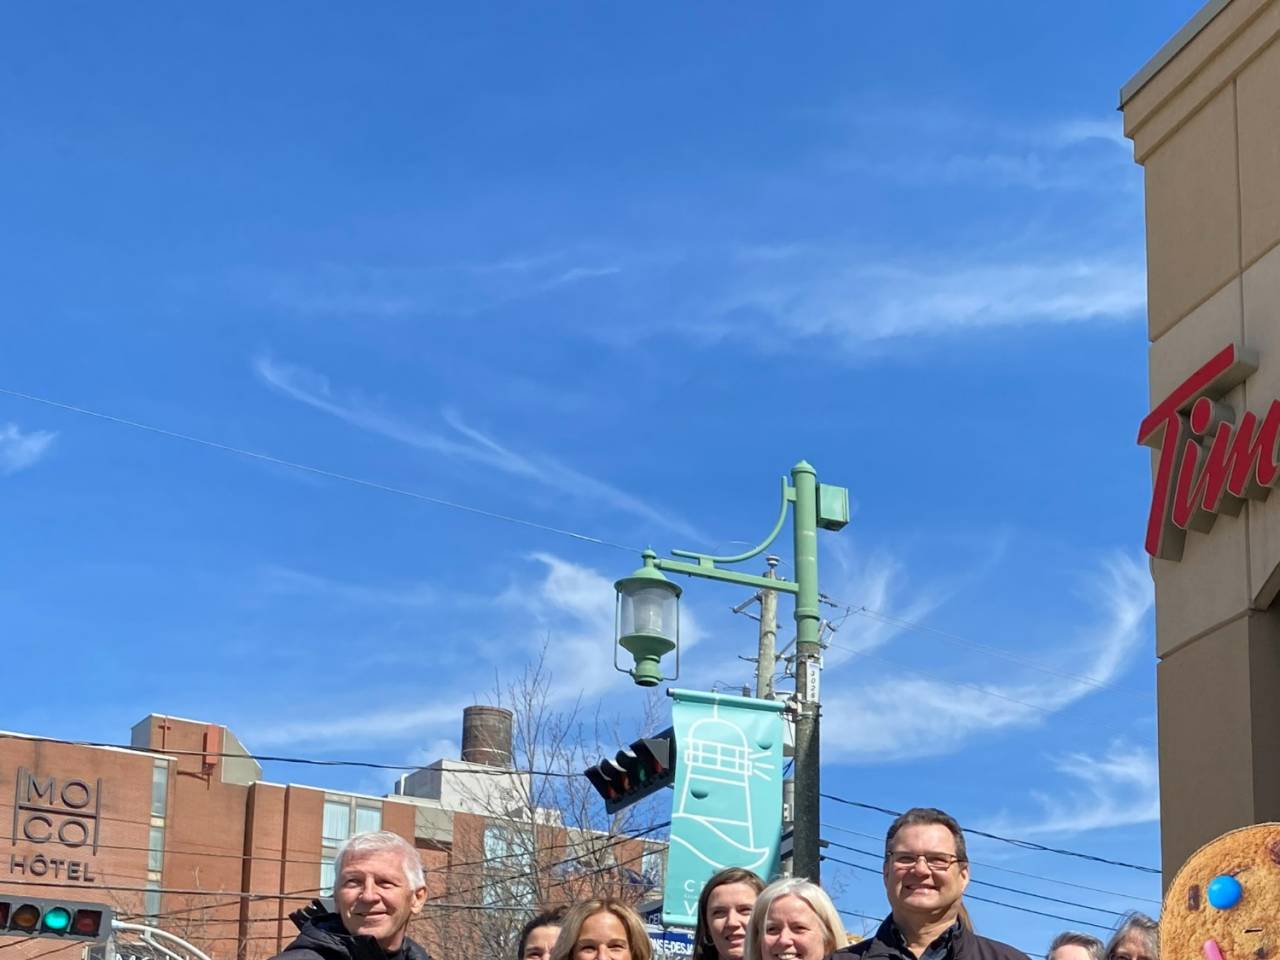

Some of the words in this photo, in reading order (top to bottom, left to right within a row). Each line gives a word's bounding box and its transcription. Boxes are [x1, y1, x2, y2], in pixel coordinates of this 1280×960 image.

[27, 772, 91, 809] MO
[23, 814, 90, 847] CO
[10, 854, 97, 882] HÔTEL
